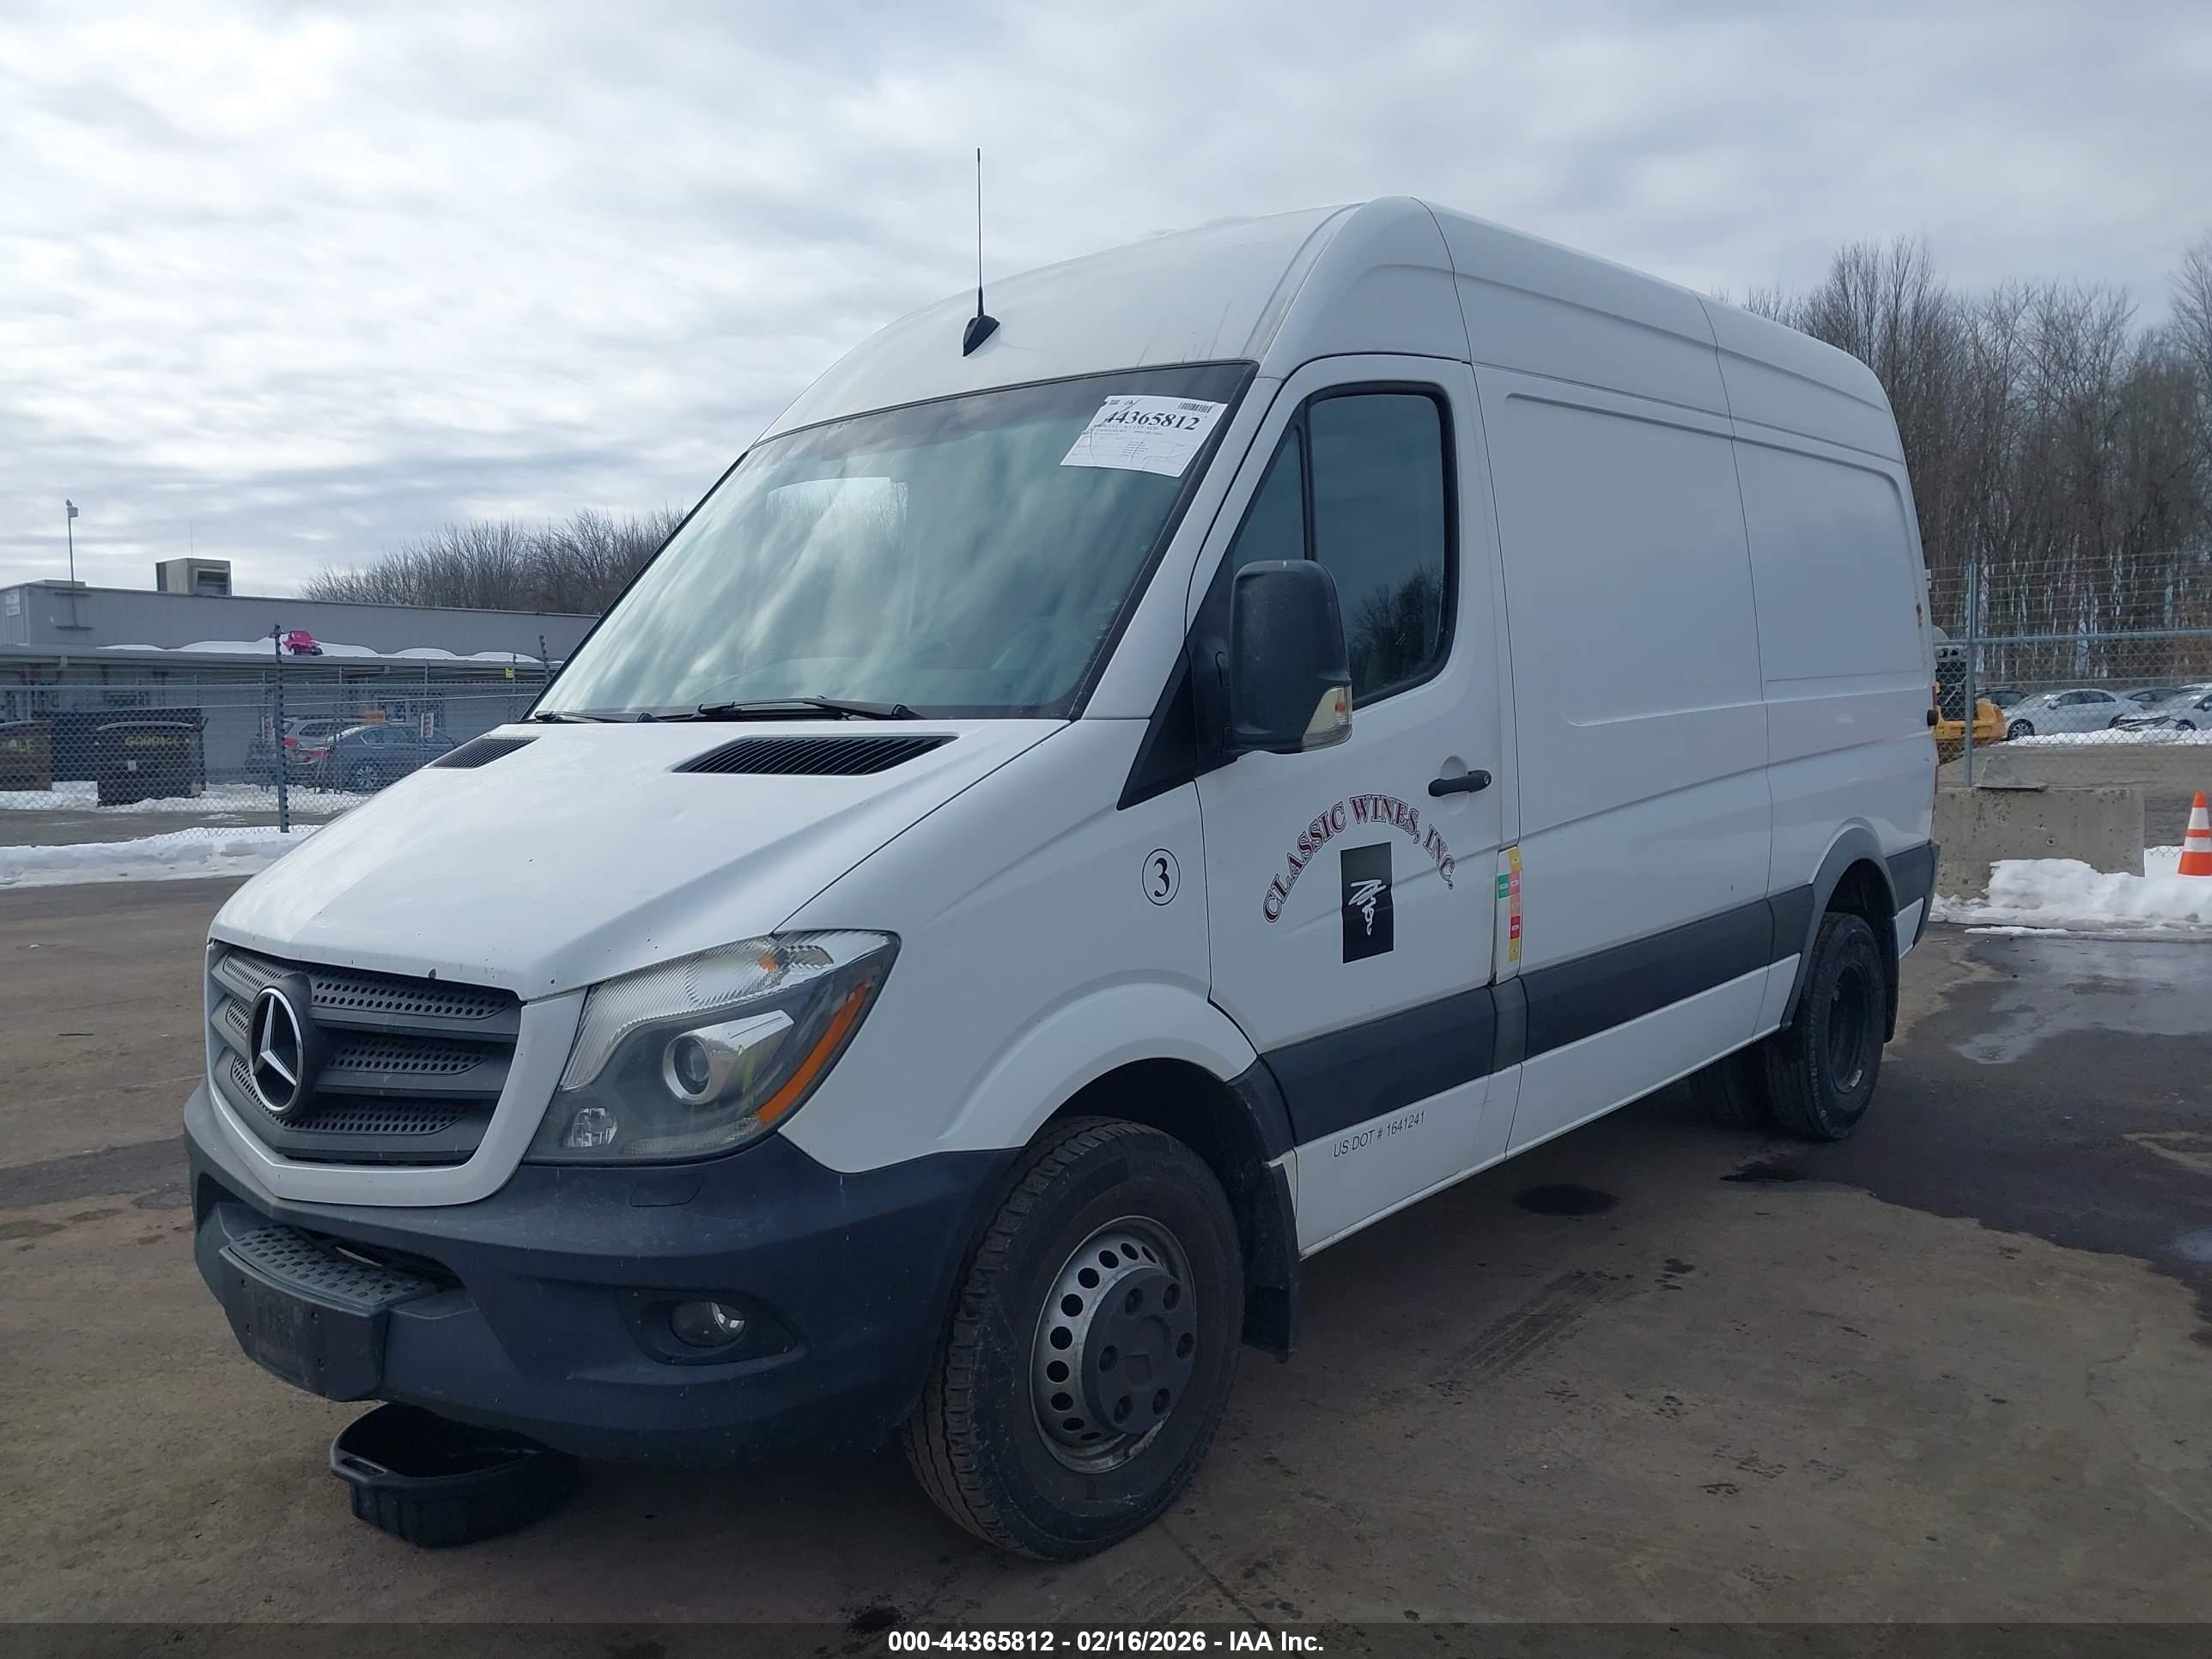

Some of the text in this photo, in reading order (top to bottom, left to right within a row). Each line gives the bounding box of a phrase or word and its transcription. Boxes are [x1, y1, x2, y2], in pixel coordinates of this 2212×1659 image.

[1105, 411, 1200, 431] 44365812
[1153, 857, 1170, 897] 3
[1263, 793, 1457, 923] CLASSIC WINES, INC.
[1334, 1110, 1425, 1158] US DOT # 1641241
